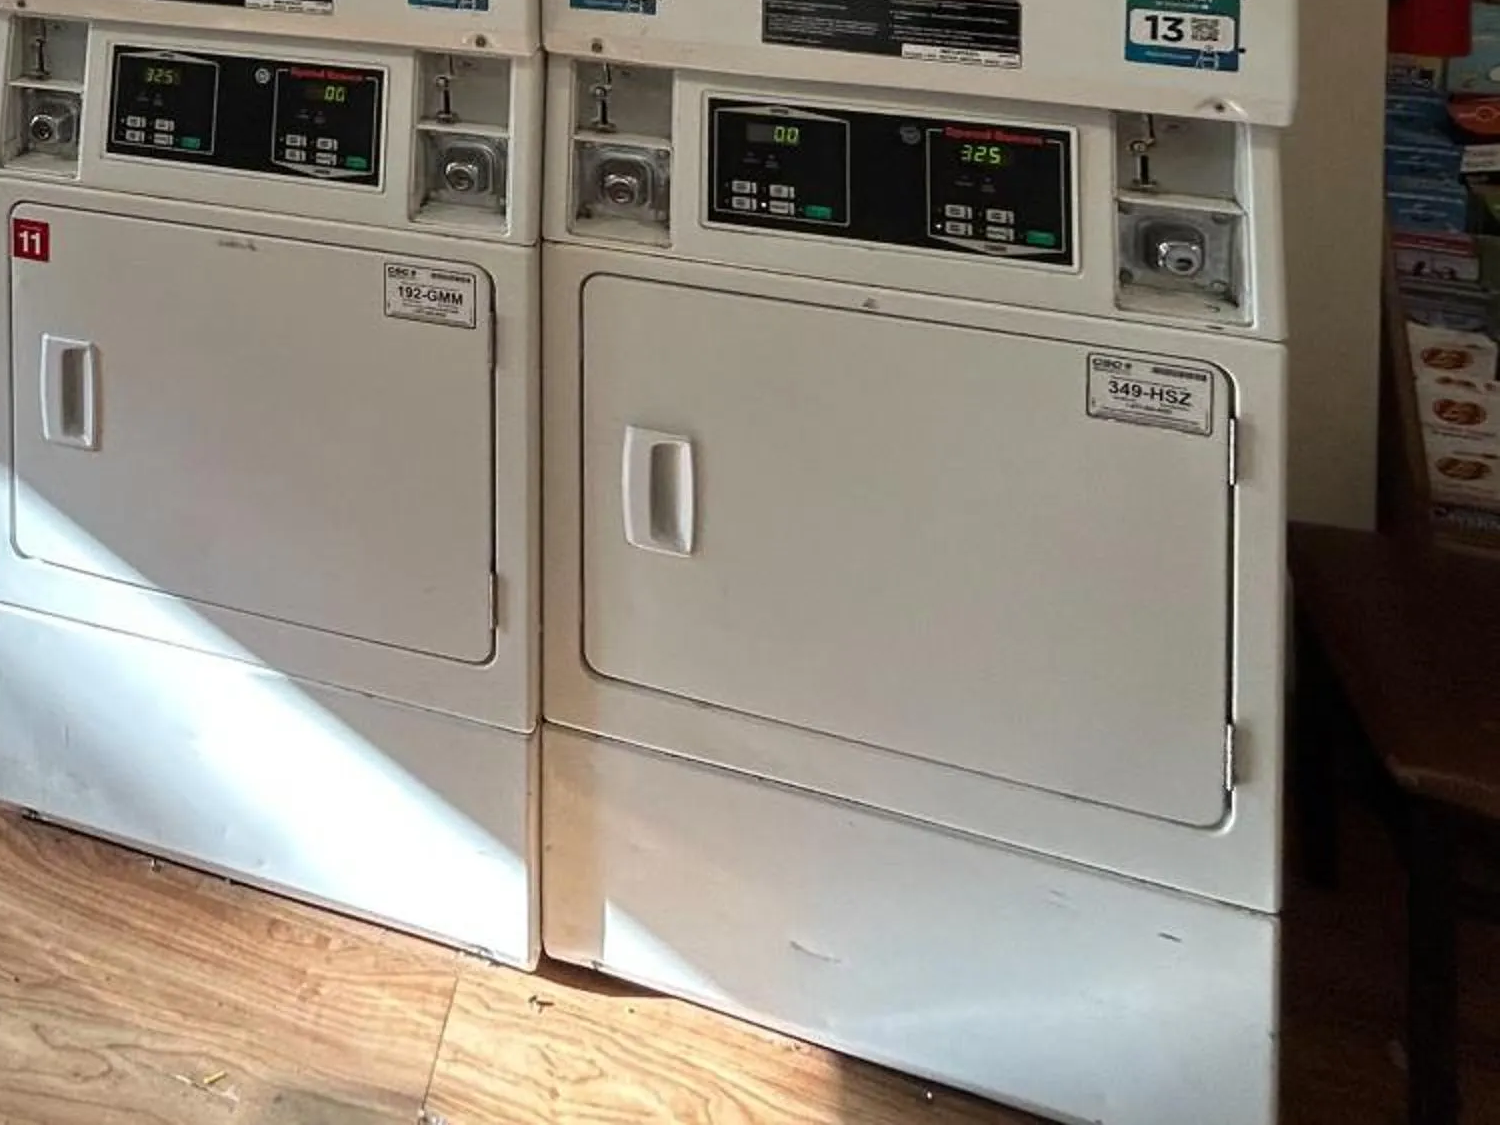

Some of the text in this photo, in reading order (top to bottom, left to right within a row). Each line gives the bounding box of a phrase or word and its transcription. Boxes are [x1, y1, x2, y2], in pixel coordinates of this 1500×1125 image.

[1144, 15, 1184, 43] 13
[961, 144, 1001, 164] 325
[18, 230, 41, 255] 11
[399, 286, 463, 305] 192-GMM
[1108, 380, 1193, 407] 349-HSZ
